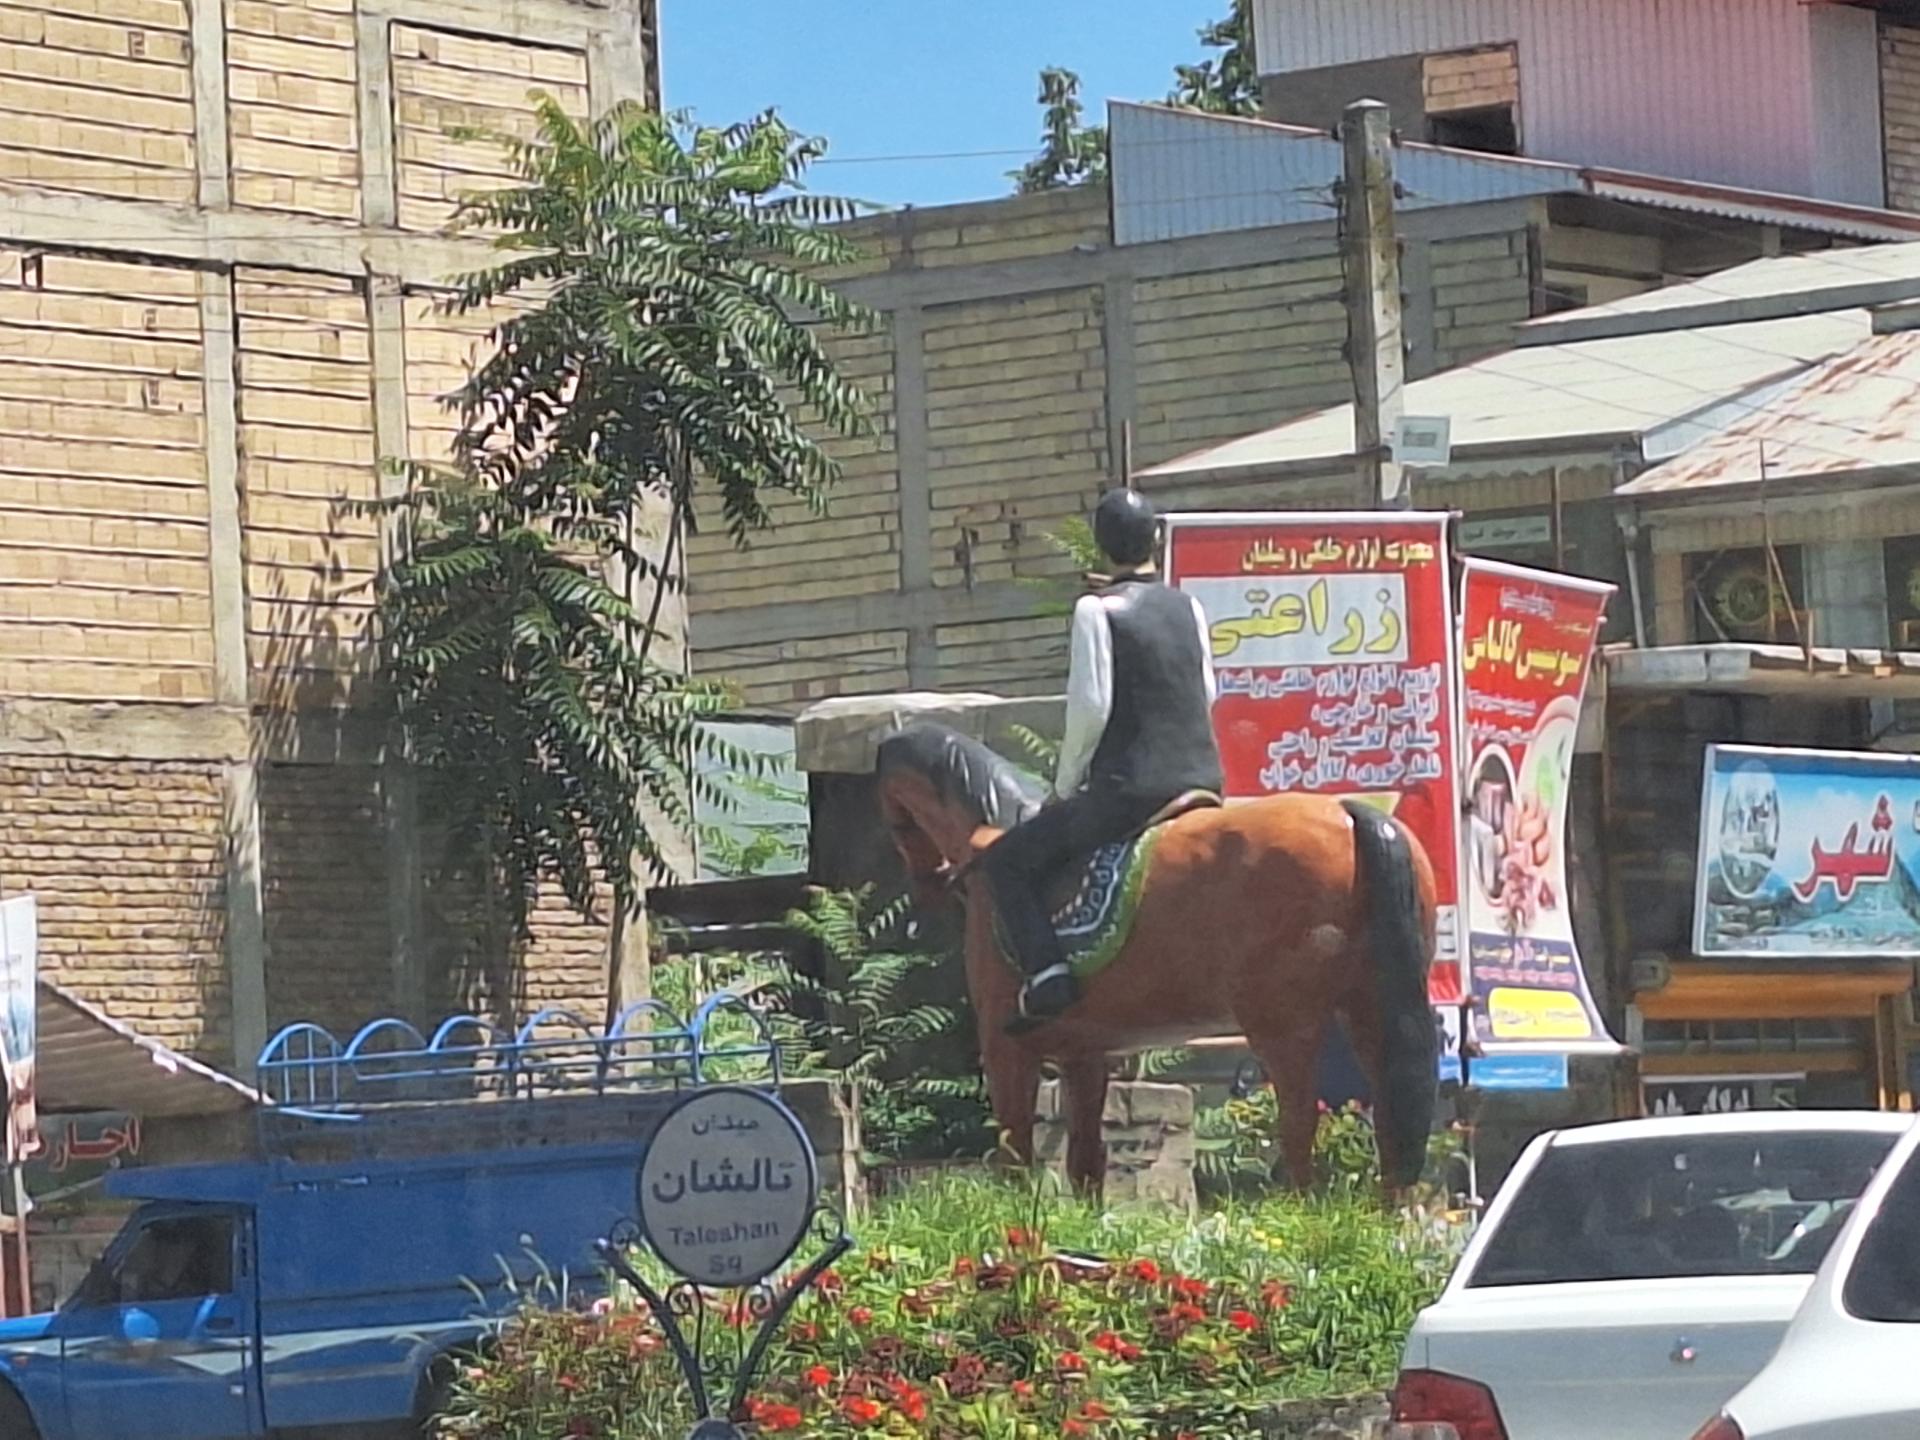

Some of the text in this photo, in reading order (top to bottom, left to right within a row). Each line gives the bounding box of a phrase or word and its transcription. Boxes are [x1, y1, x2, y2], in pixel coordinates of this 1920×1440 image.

[1346, 536, 1381, 569] لوازم
[1515, 649, 1583, 687] سوسیس
[1792, 792, 1894, 901] شهر
[691, 1114, 760, 1137] میدان
[652, 1156, 796, 1203] تالشان
[668, 1221, 779, 1247] Taleshan
